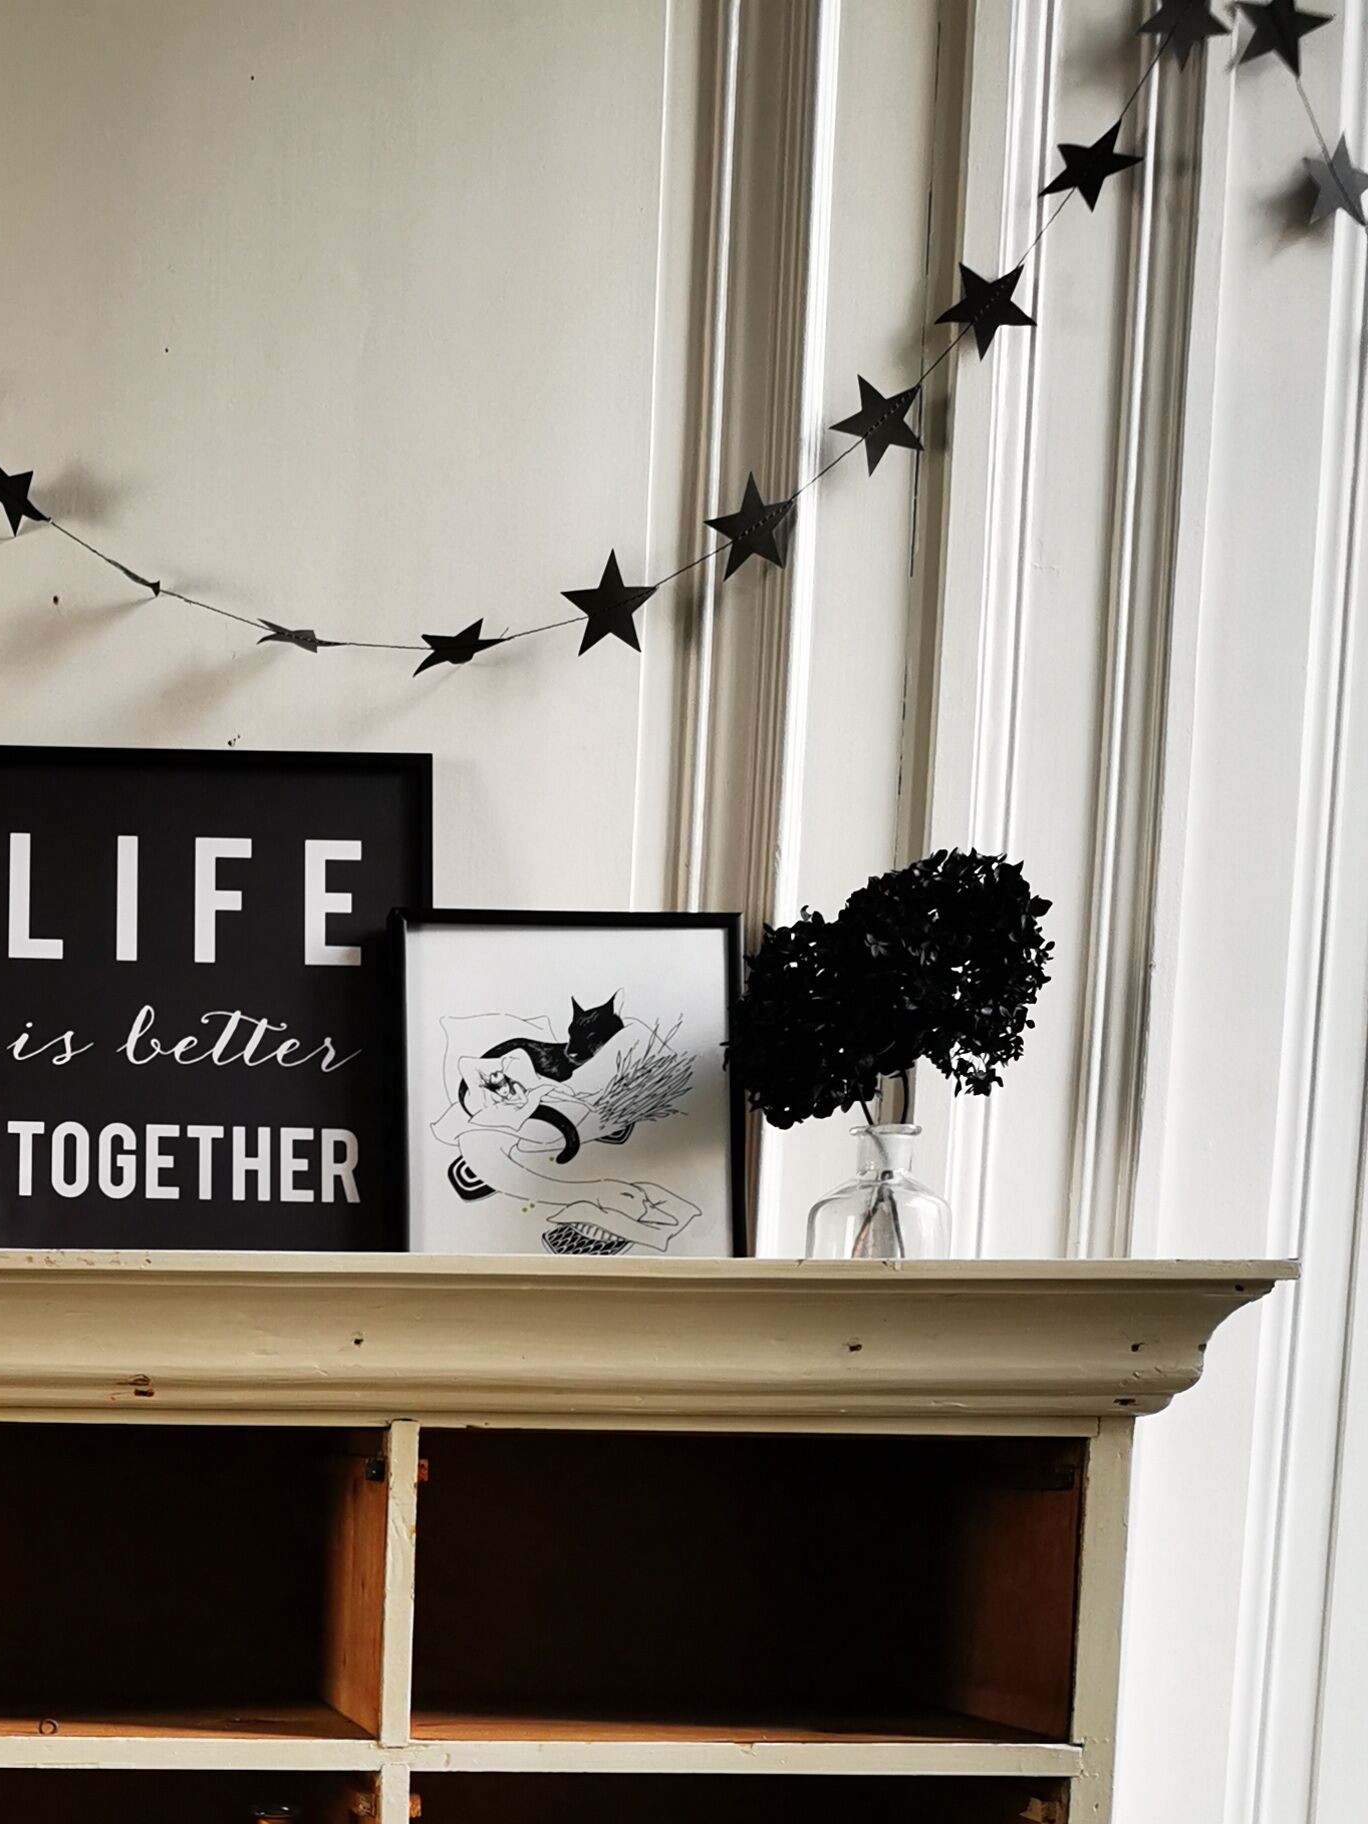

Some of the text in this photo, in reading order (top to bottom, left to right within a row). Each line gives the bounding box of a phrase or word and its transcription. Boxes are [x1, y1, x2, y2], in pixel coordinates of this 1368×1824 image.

[8, 832, 362, 966] LIFE
[7, 1004, 363, 1073] is better
[7, 1120, 361, 1204] TOGETHER
